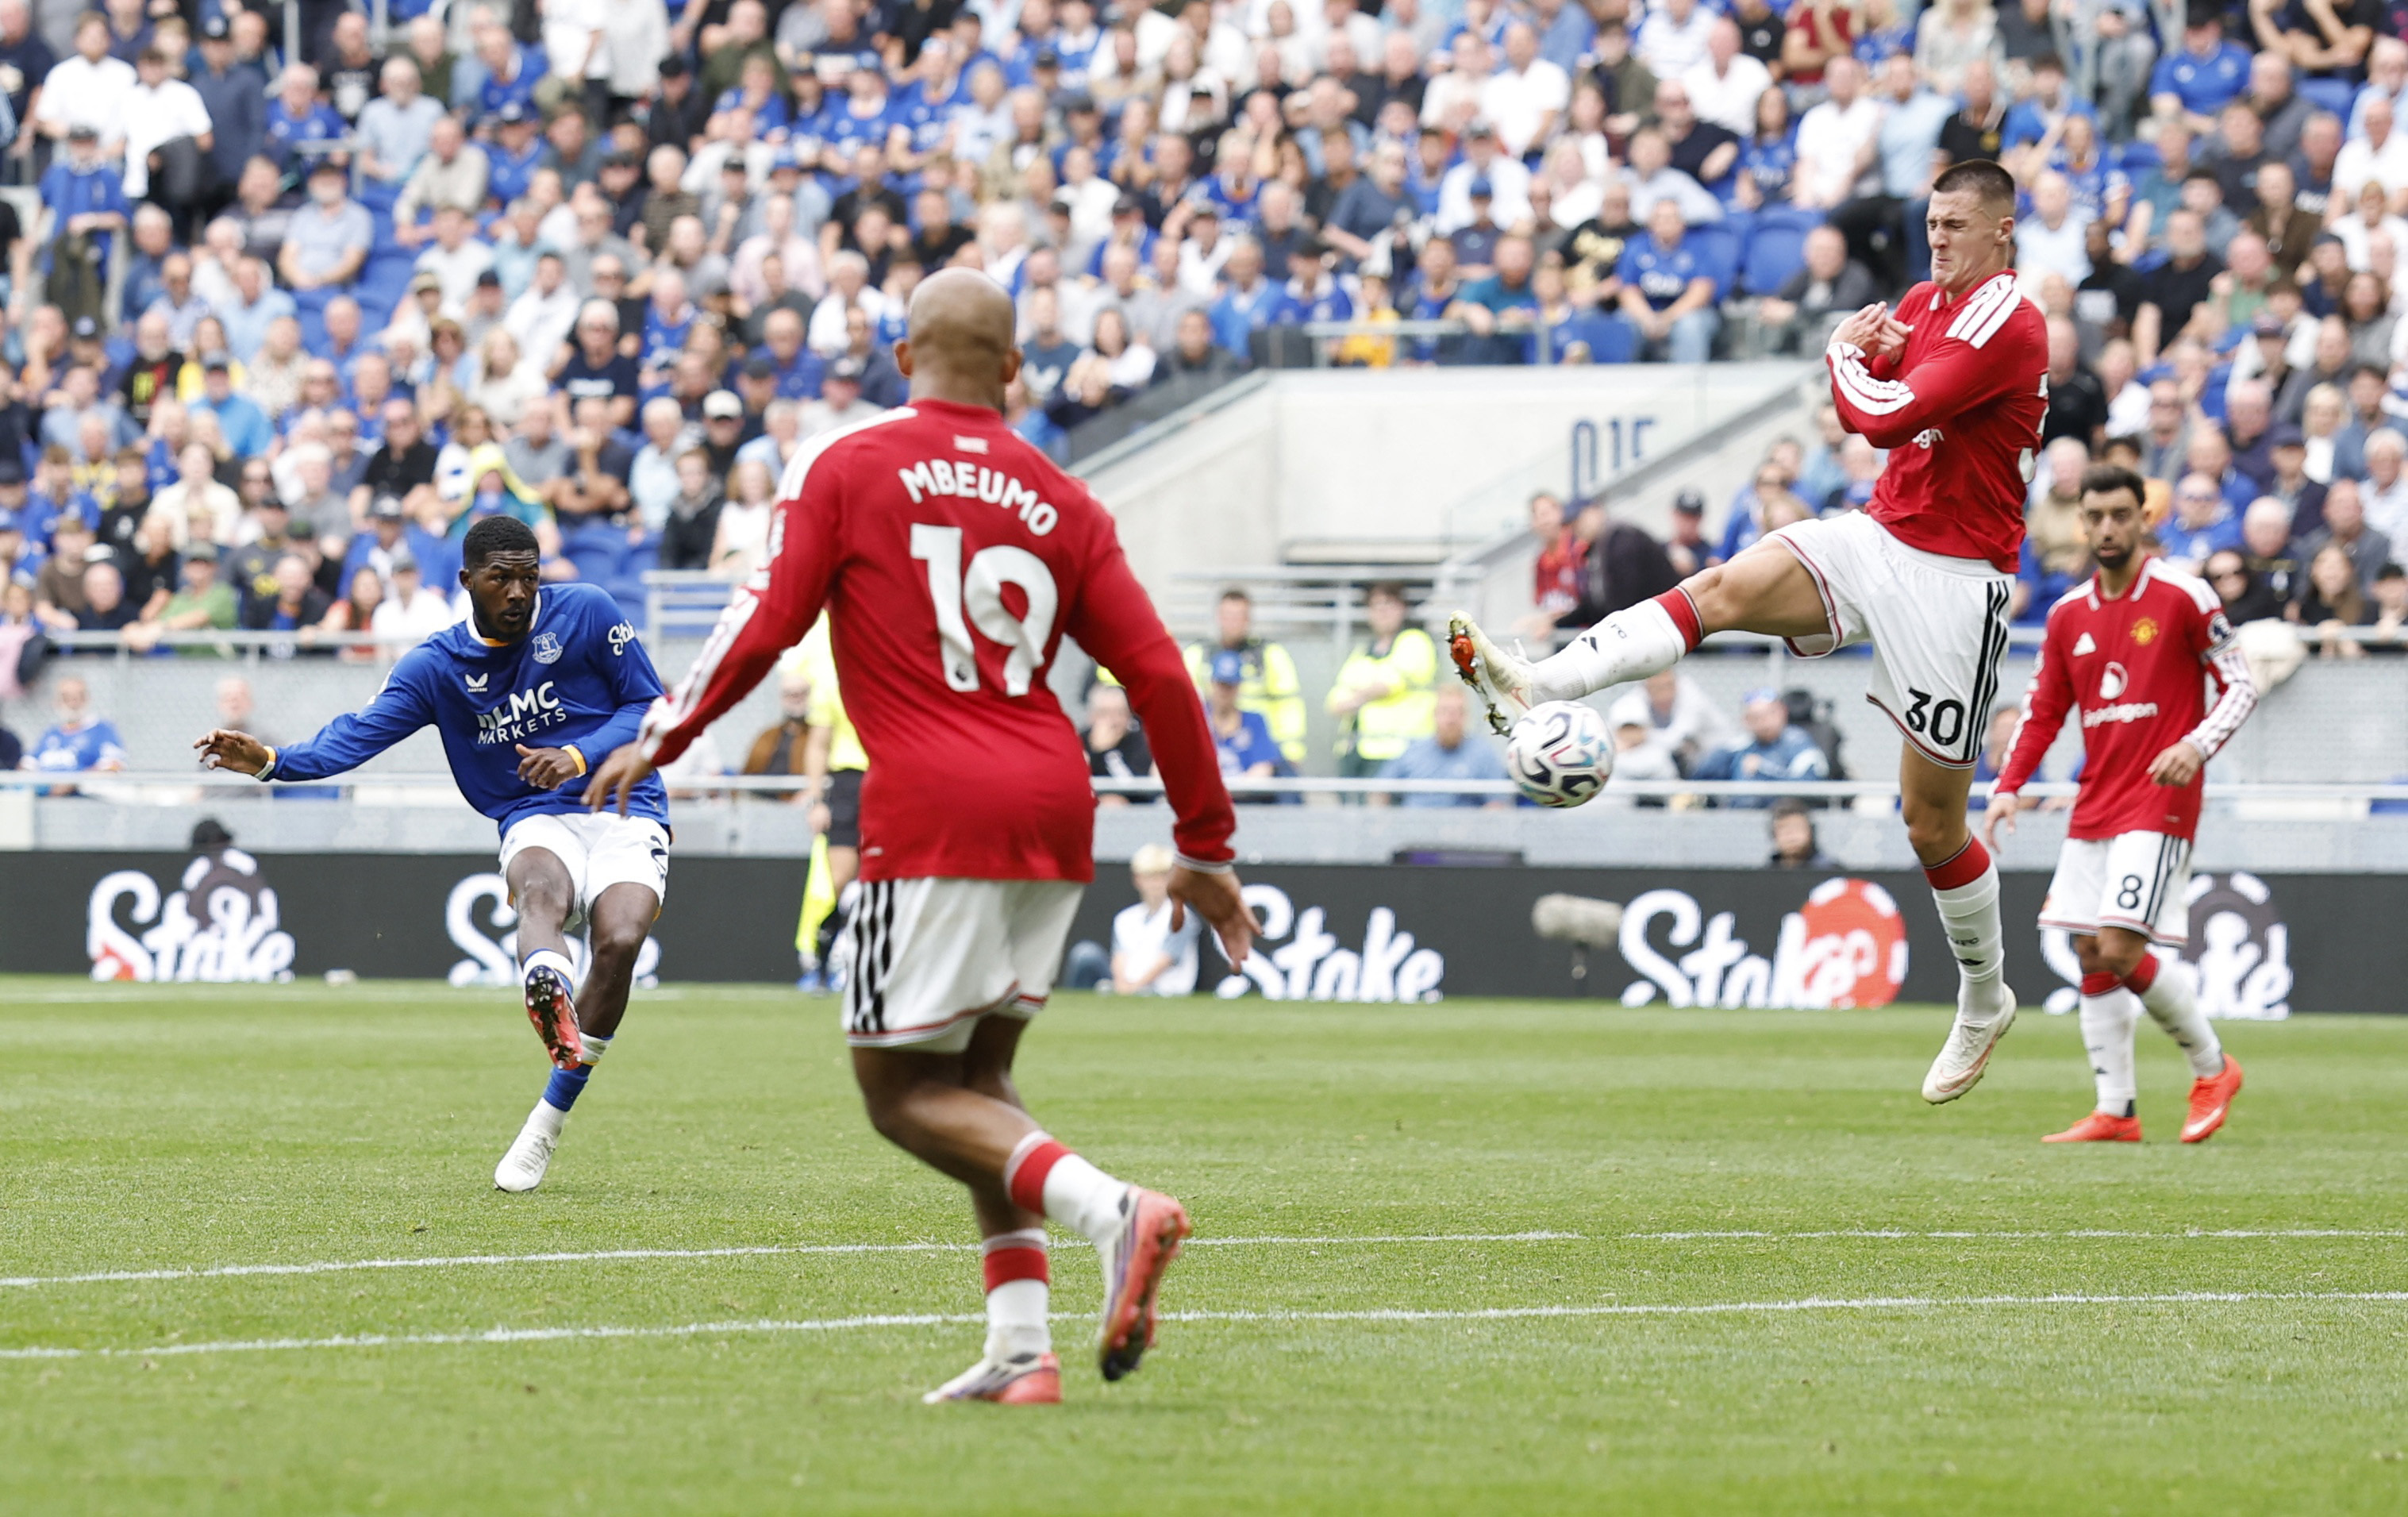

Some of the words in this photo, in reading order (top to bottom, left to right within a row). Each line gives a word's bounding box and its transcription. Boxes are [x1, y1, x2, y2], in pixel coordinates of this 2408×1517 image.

[898, 458, 1059, 537] MBEUMO
[910, 522, 1059, 698] 19
[478, 707, 567, 744] MARKETS
[1906, 686, 1964, 745] 30
[2117, 874, 2142, 910] 8
[1211, 883, 1444, 1004] Stake
[1618, 887, 1859, 1011] Stake
